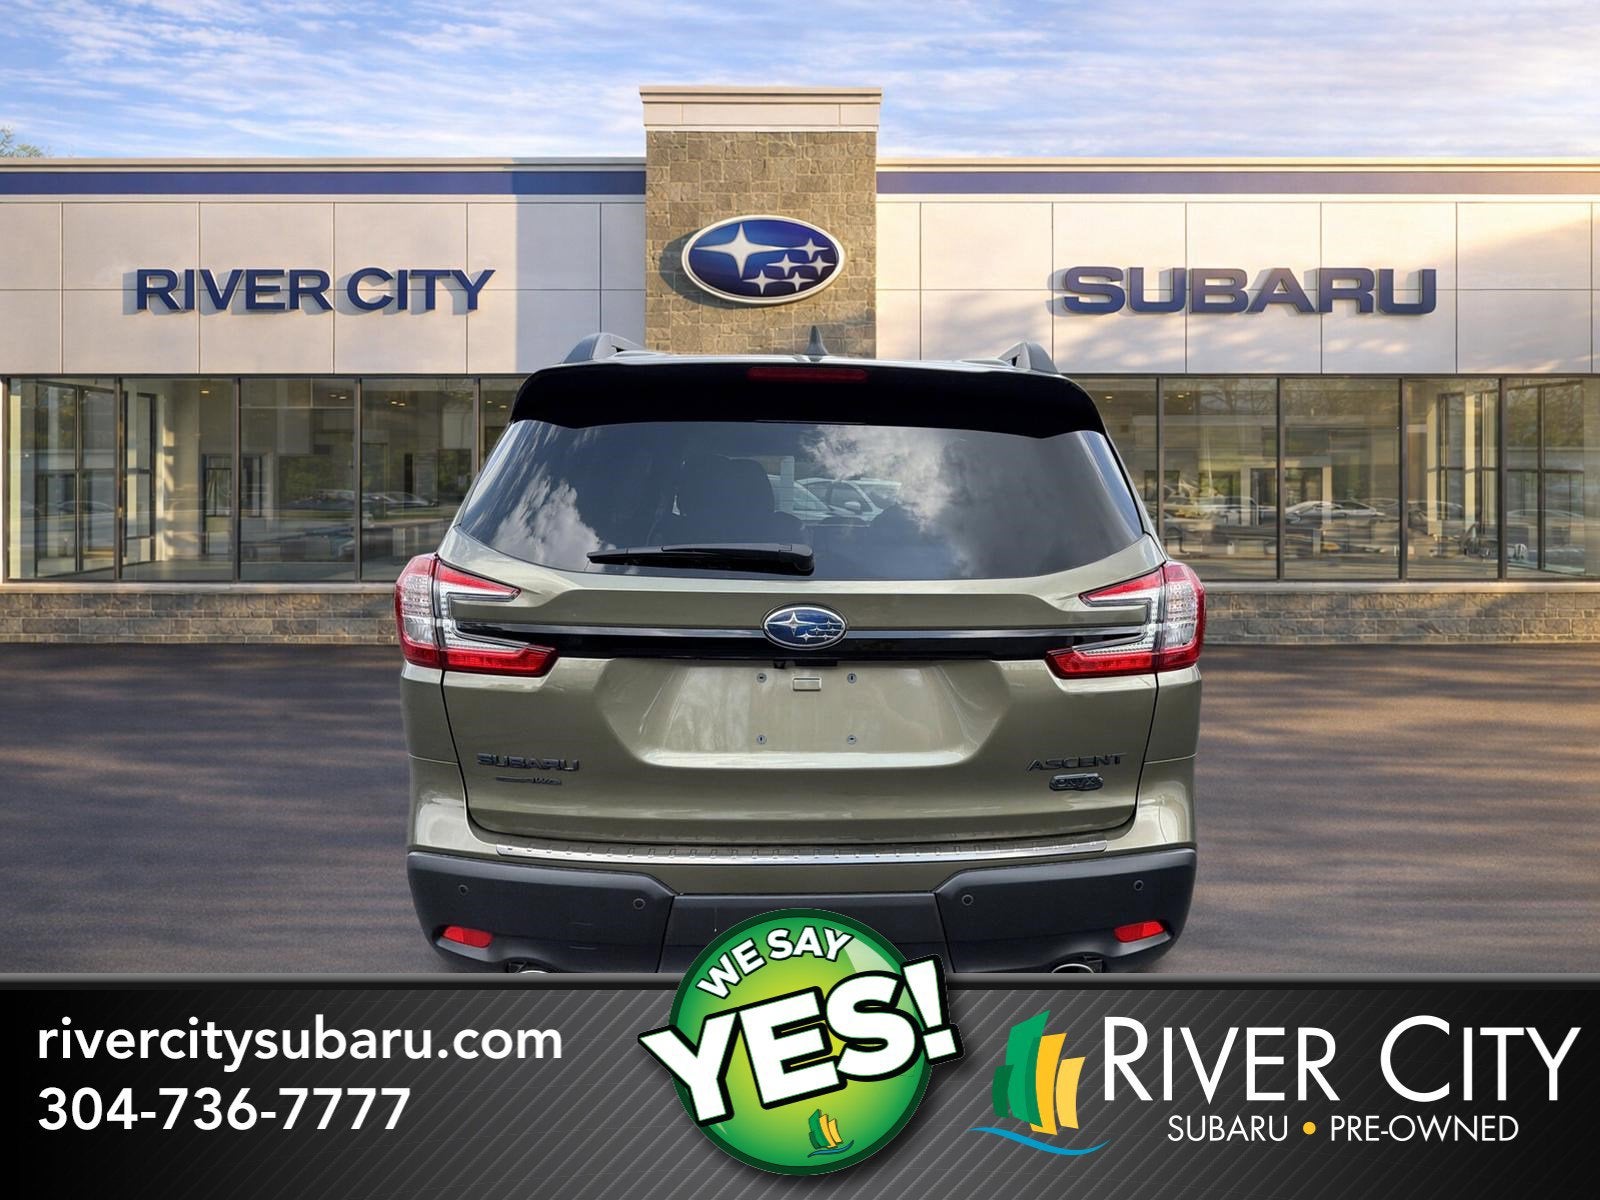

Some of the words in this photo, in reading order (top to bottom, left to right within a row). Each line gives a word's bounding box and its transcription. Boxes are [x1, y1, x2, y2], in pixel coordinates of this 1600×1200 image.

[136, 268, 334, 312] RIVER
[346, 267, 496, 311] CITY
[1063, 266, 1437, 316] SUBARU
[477, 752, 580, 772] SUBARU
[1027, 752, 1127, 772] ASCENT
